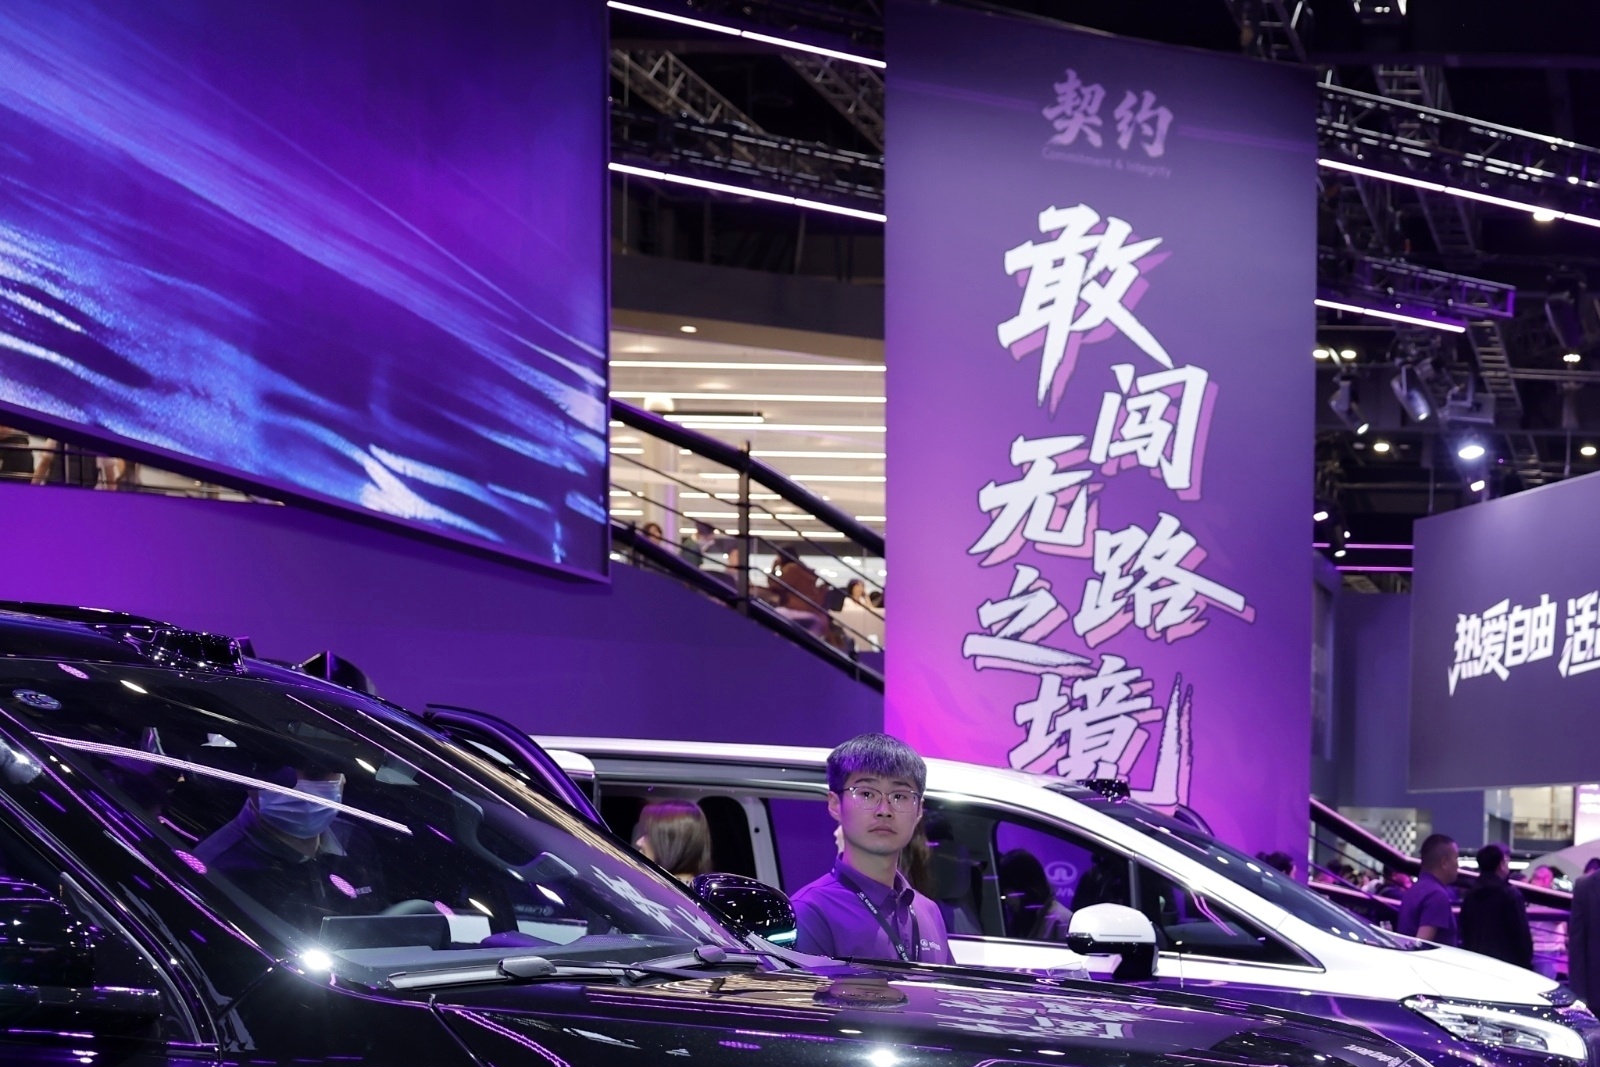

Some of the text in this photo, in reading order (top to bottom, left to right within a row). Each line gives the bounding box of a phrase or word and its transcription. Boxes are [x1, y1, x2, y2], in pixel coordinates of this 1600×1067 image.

[1042, 69, 1174, 157] 契约
[1448, 594, 1557, 698] 热爱自由
